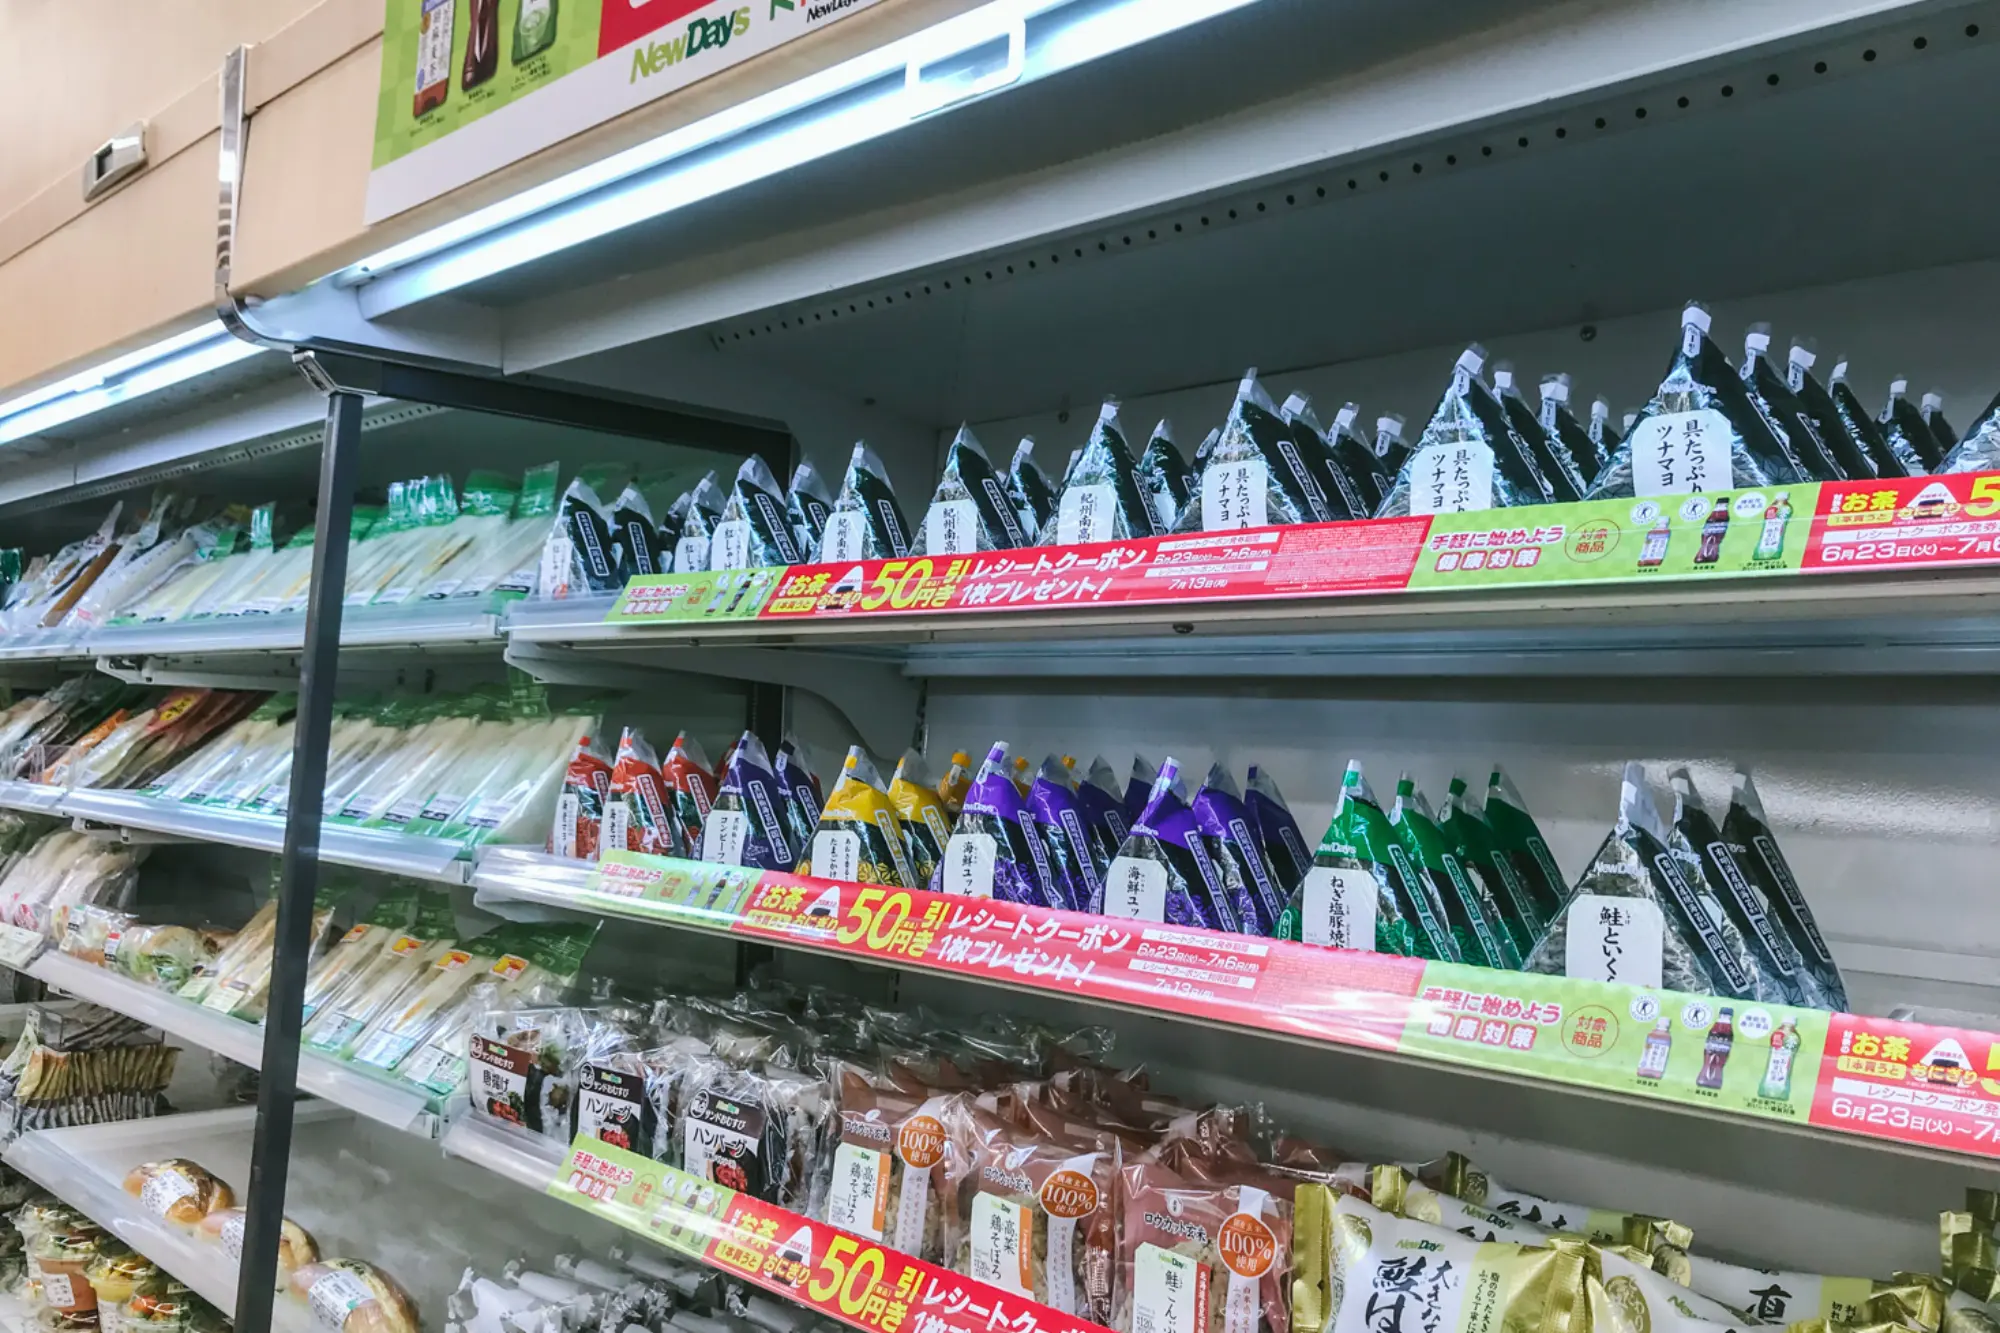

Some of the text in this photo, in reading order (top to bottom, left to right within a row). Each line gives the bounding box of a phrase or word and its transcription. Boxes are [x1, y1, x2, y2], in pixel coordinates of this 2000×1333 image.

[630, 6, 751, 84] NewDays
[1656, 425, 1674, 488] ツナマヨ
[1431, 453, 1447, 508] ツナマヨ
[1219, 471, 1231, 522] ツナマヨ
[1842, 489, 1899, 512] お茶
[943, 507, 957, 555] 紀州南高
[1077, 492, 1095, 544] 紀州南高
[836, 518, 848, 563] 紀州南高
[1428, 525, 1566, 551] 手軽に始めよう
[971, 546, 1149, 579] レシートクーポン
[1434, 546, 1543, 573] 健康対策
[719, 816, 728, 864] コンビーフ
[1126, 866, 1142, 917] 海鮮ユッ
[949, 905, 1131, 953] レシートクーポン
[1422, 986, 1562, 1025] 手軽に始めよう
[1578, 1014, 1608, 1033] 対象
[1571, 1032, 1603, 1049] 商品
[1852, 1031, 1912, 1062] お茶
[1846, 1057, 1900, 1078] 1本買うと
[1911, 1062, 1978, 1085] おにぎり
[901, 1129, 943, 1154] 100%
[910, 1151, 931, 1164] 使用
[1043, 1183, 1094, 1211] 100%
[1054, 1204, 1077, 1216] 使用
[1143, 1211, 1207, 1244] ロウカット玄米
[1460, 1204, 1516, 1231] NewDays
[990, 1213, 1002, 1280] 鶏そぼろ
[1222, 1229, 1272, 1261] 100%
[1395, 1239, 1446, 1253] NewDays
[763, 1254, 812, 1285] おにぎり
[1235, 1256, 1257, 1273] 使用
